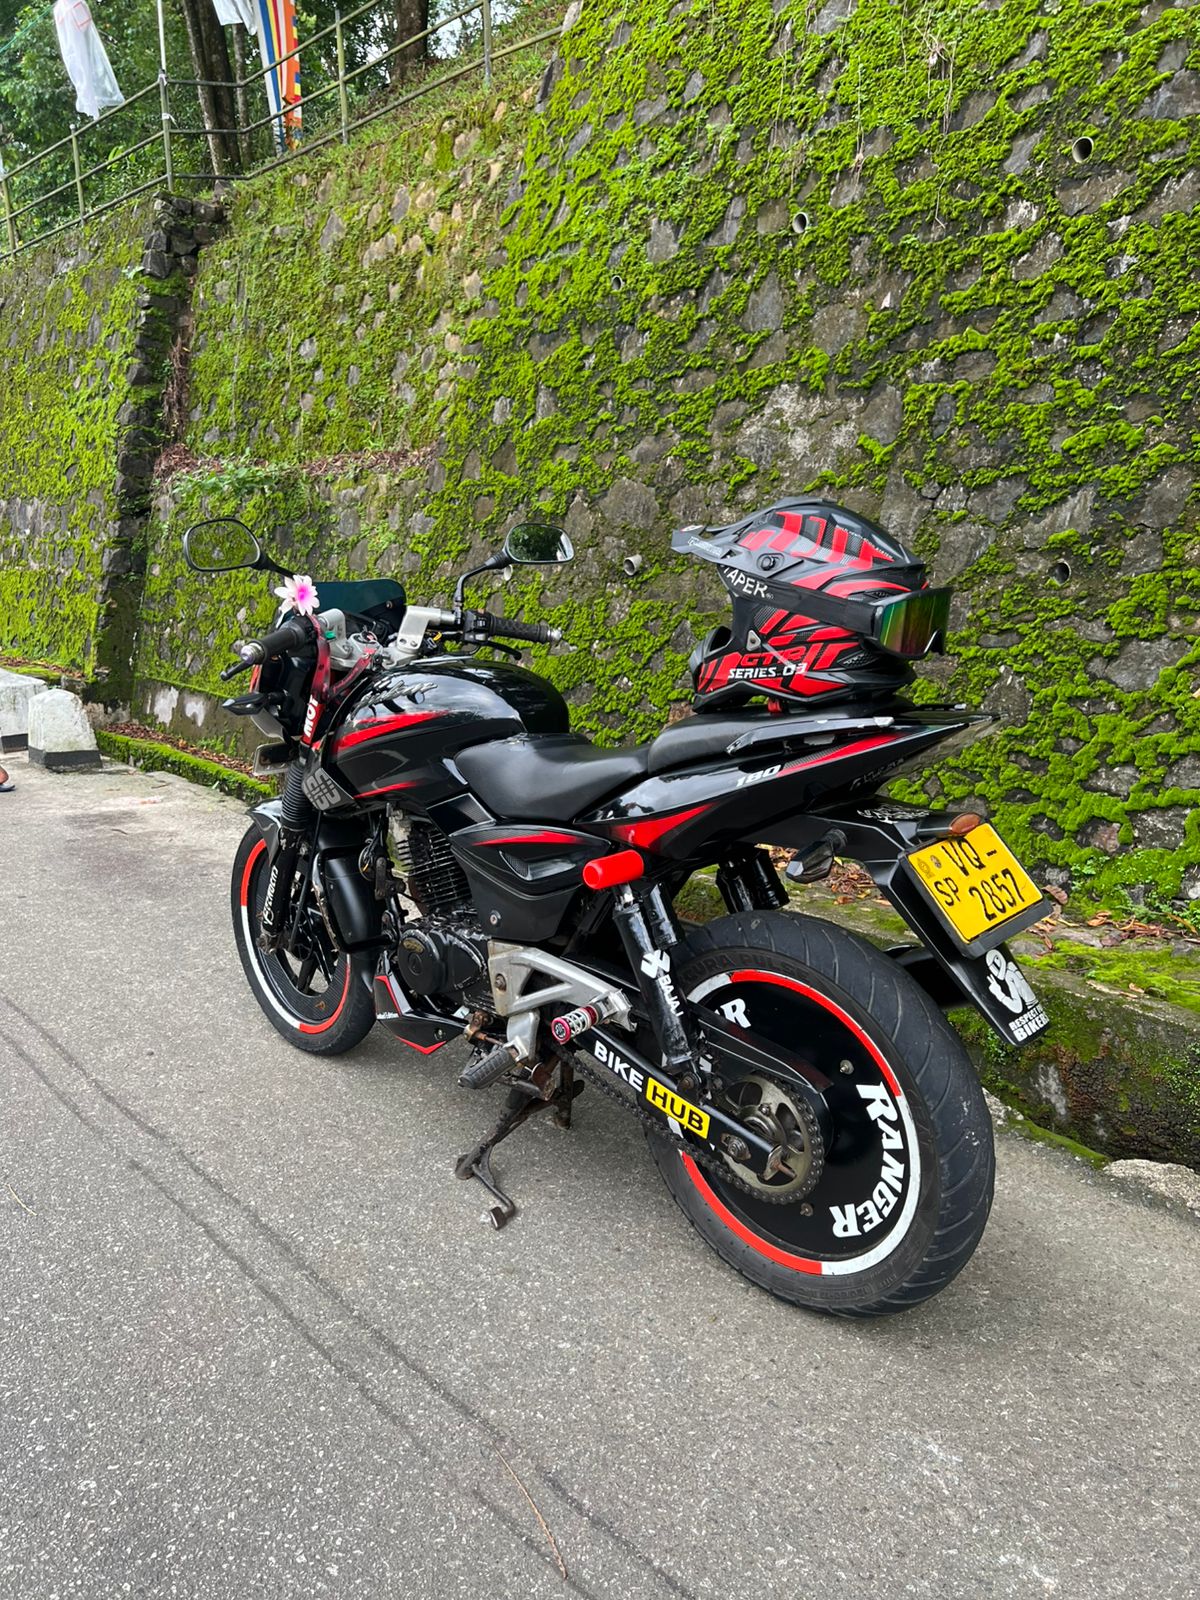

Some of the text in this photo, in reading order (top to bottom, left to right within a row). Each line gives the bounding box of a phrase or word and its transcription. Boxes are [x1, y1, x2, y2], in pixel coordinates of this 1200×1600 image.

[728, 667, 777, 679] SERIES
[736, 764, 781, 787] 180
[933, 876, 961, 907] SP
[968, 868, 1025, 921] 2857
[656, 974, 684, 1017] BAJAJ
[1008, 1006, 1040, 1031] RESPECT
[594, 1040, 704, 1132] BIKE HUB
[829, 1081, 905, 1238] RANGER
